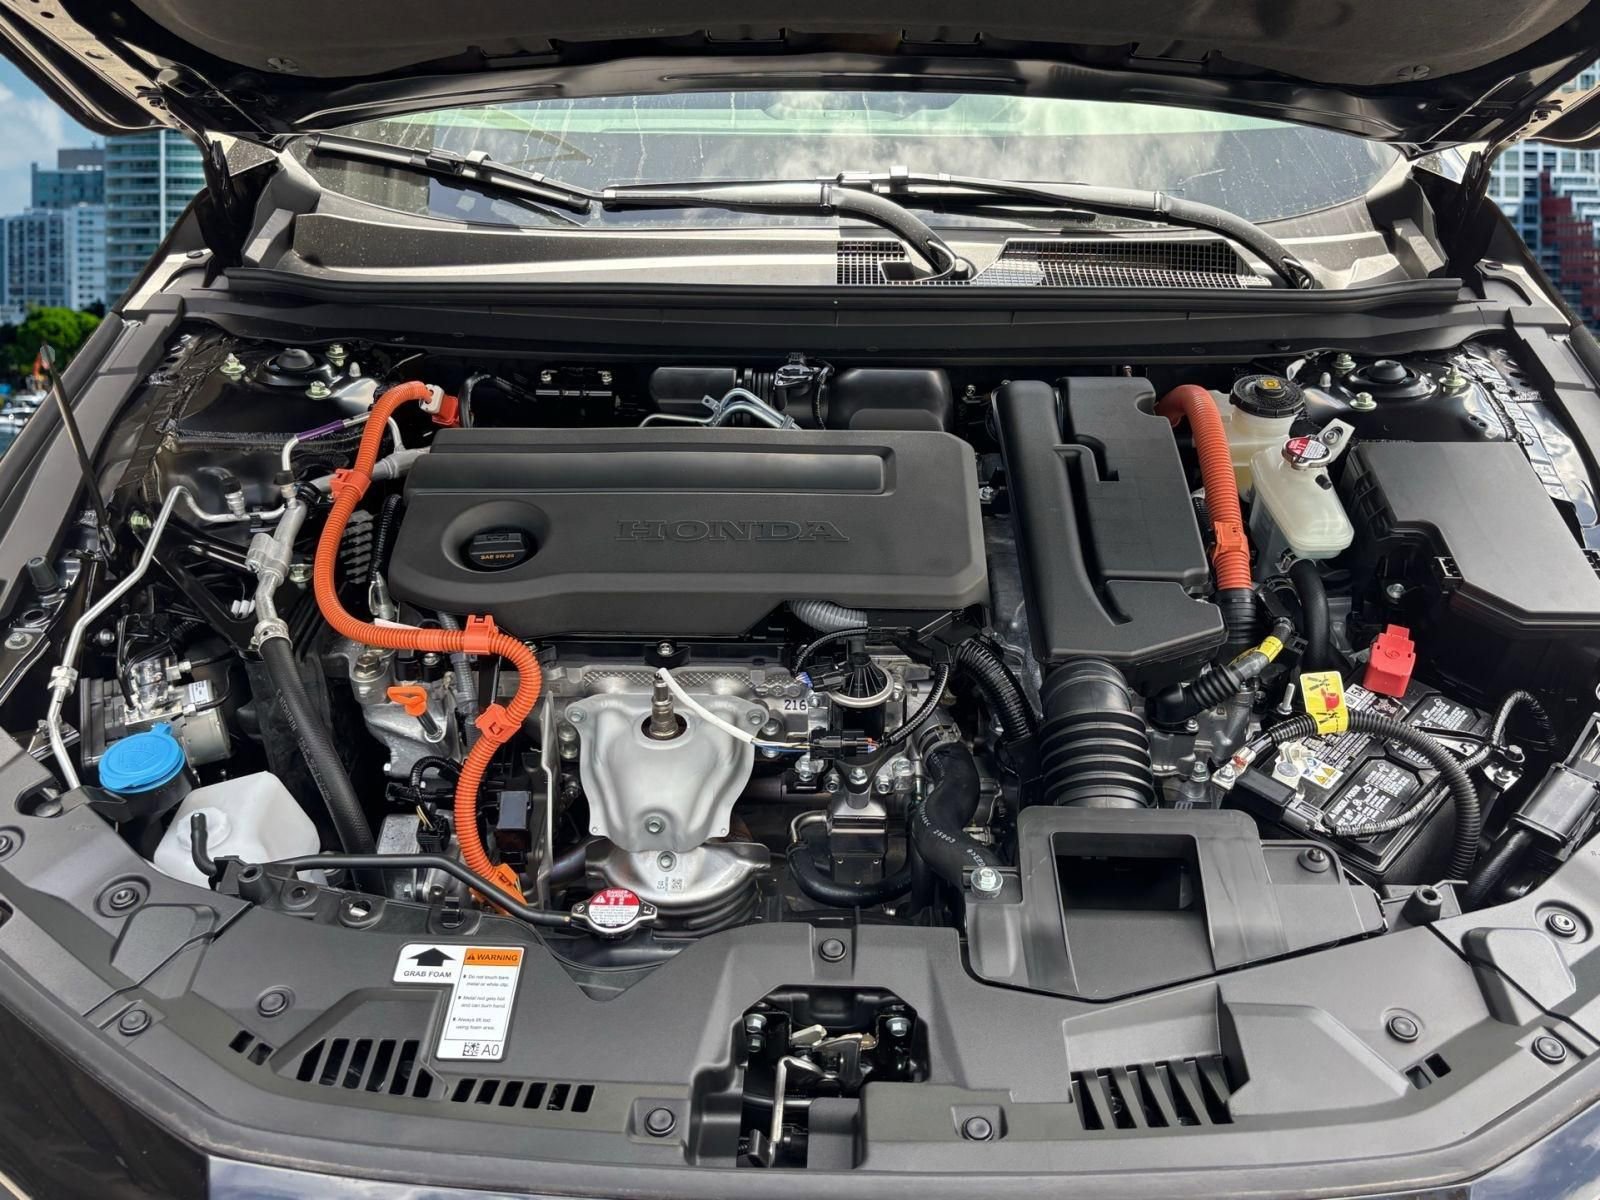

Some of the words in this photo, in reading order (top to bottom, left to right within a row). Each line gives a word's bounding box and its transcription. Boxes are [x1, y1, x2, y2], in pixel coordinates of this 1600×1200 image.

[614, 519, 851, 542] HONDA
[784, 699, 807, 711] 216
[477, 953, 518, 962] WARNING
[403, 970, 427, 978] GRAB
[428, 970, 452, 978] FOAM
